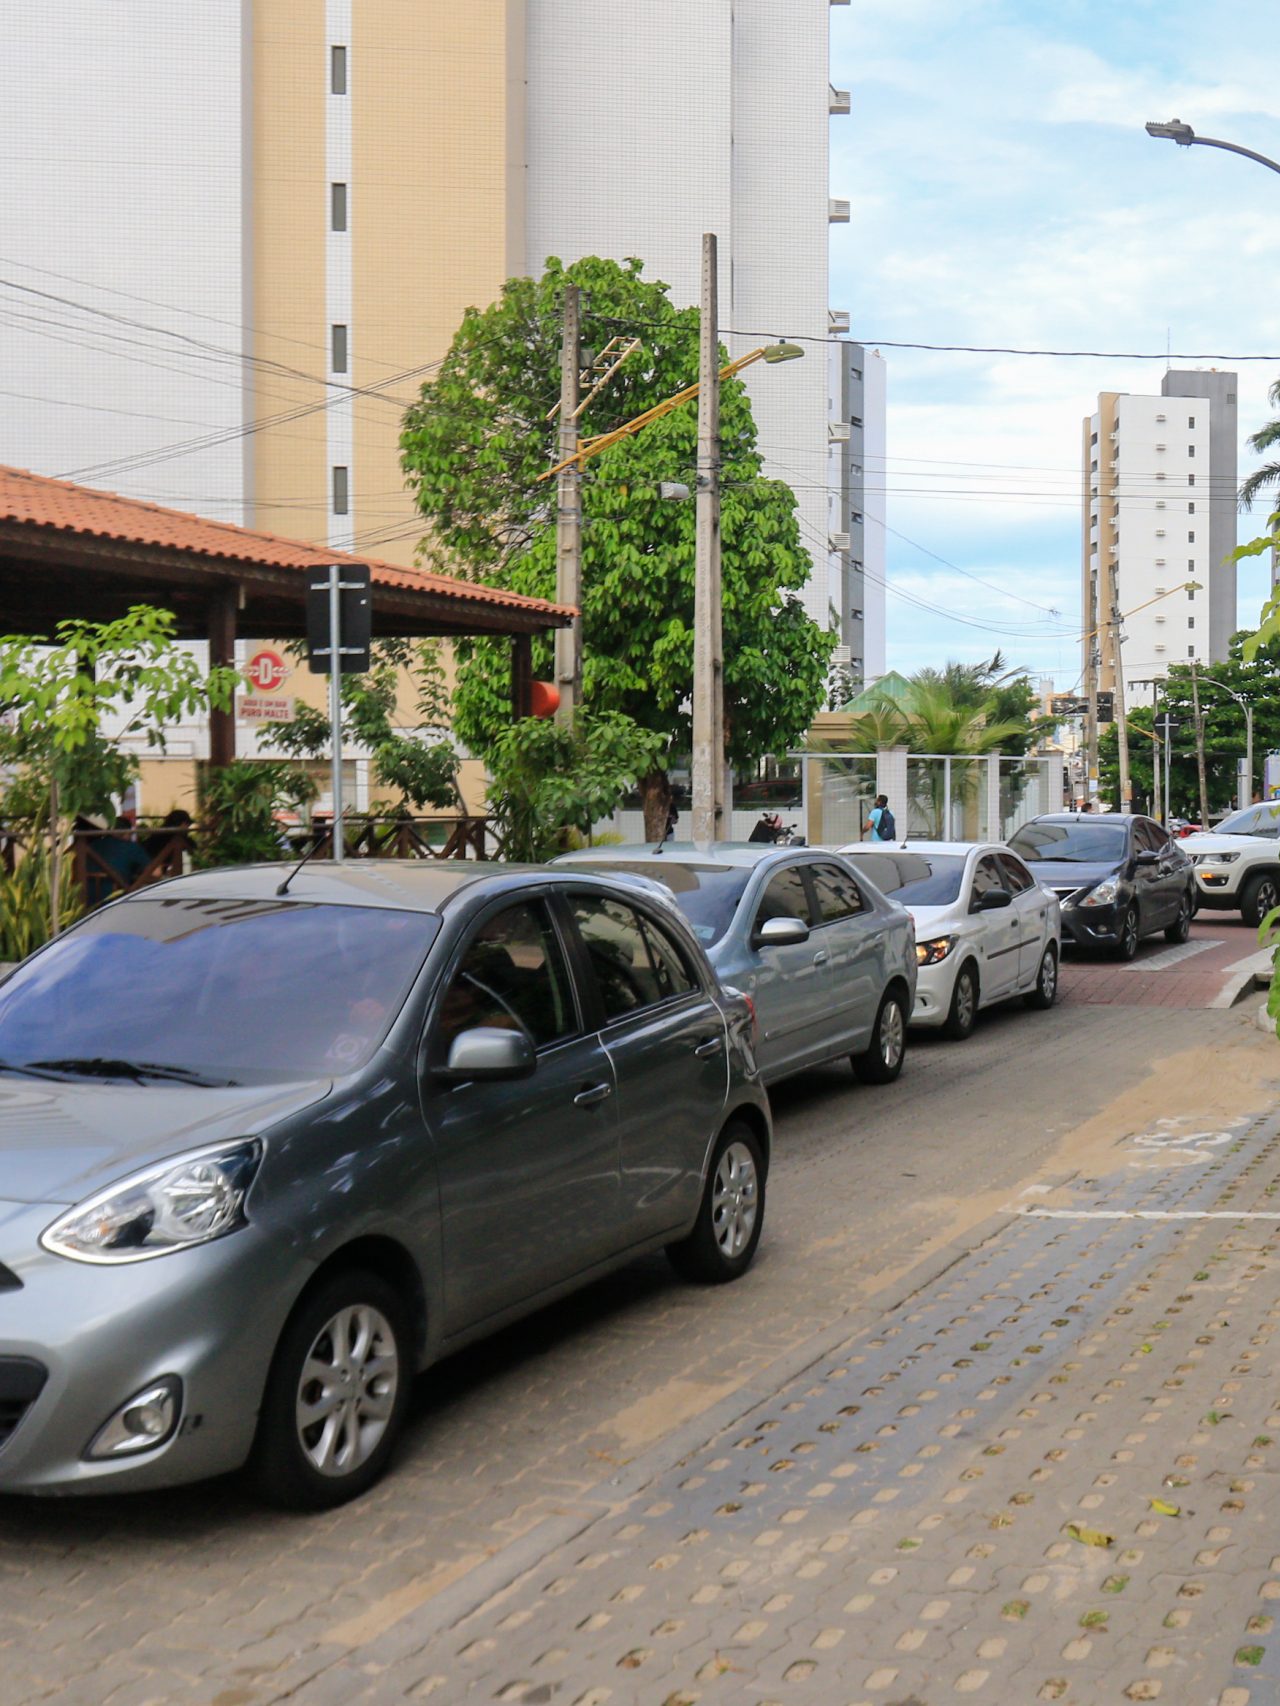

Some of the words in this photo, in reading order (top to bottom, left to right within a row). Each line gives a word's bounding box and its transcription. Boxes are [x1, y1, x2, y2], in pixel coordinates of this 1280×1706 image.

[259, 658, 272, 684] D
[240, 707, 262, 717] PURO
[263, 709, 289, 719] MALTE
